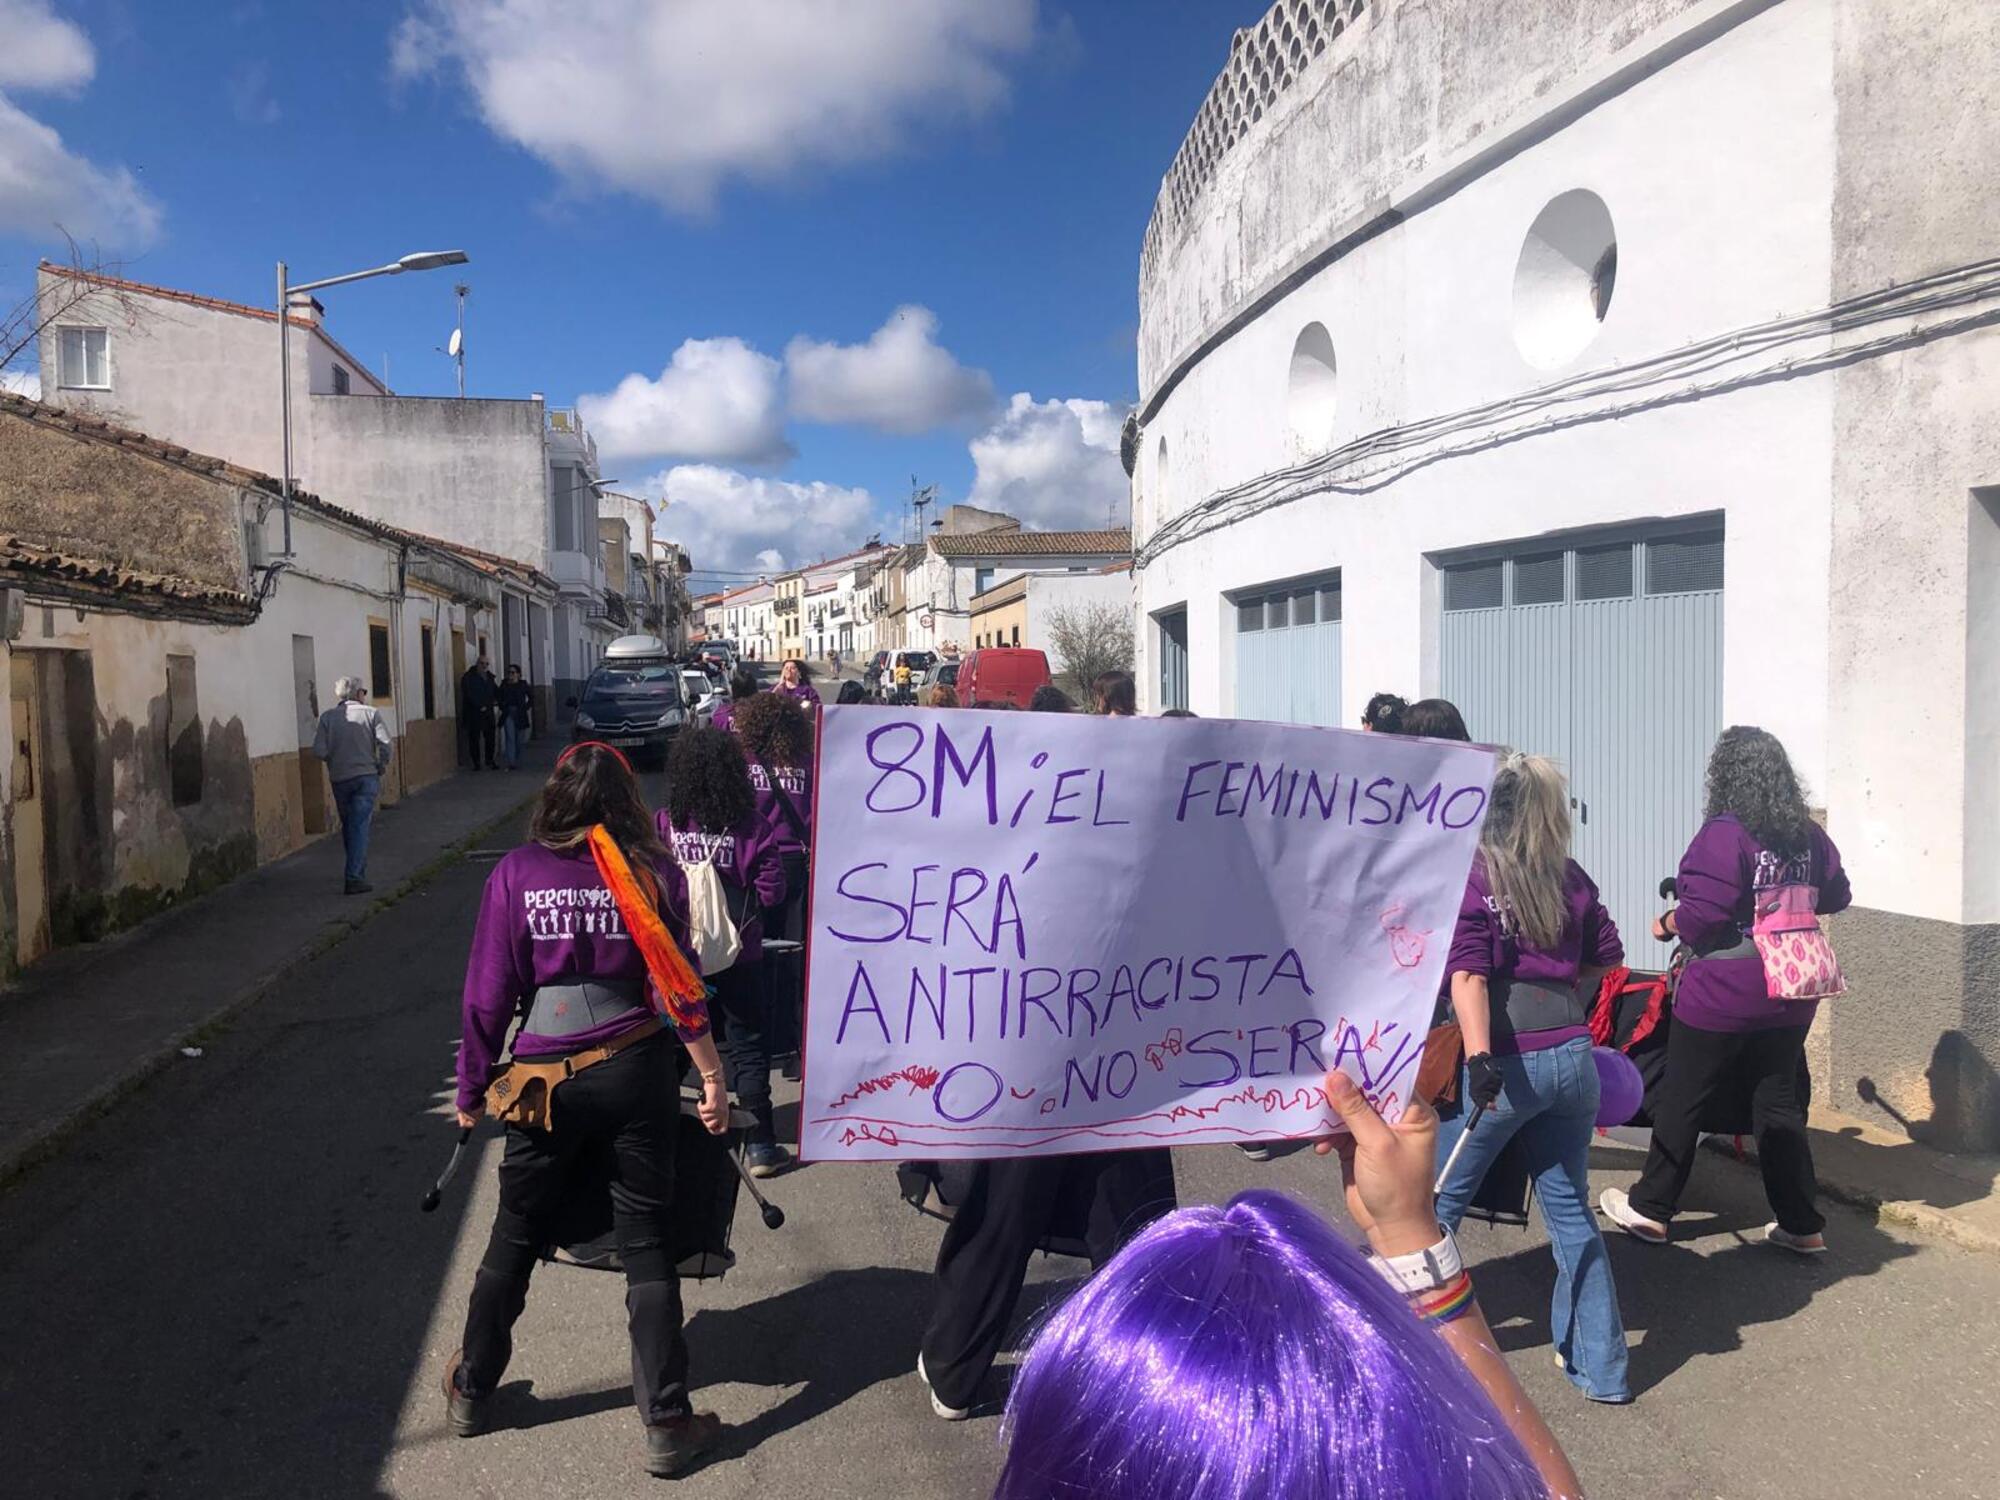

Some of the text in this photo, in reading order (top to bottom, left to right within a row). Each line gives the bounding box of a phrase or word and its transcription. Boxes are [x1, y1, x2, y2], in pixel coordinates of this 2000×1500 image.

[865, 721, 999, 825] 8M
[1176, 761, 1486, 829] FEMINISMO
[828, 852, 1039, 960] SERÁ
[836, 948, 1314, 1045] ANTIRRACISTA
[933, 1062, 1003, 1123] O
[1062, 1050, 1137, 1109] NO
